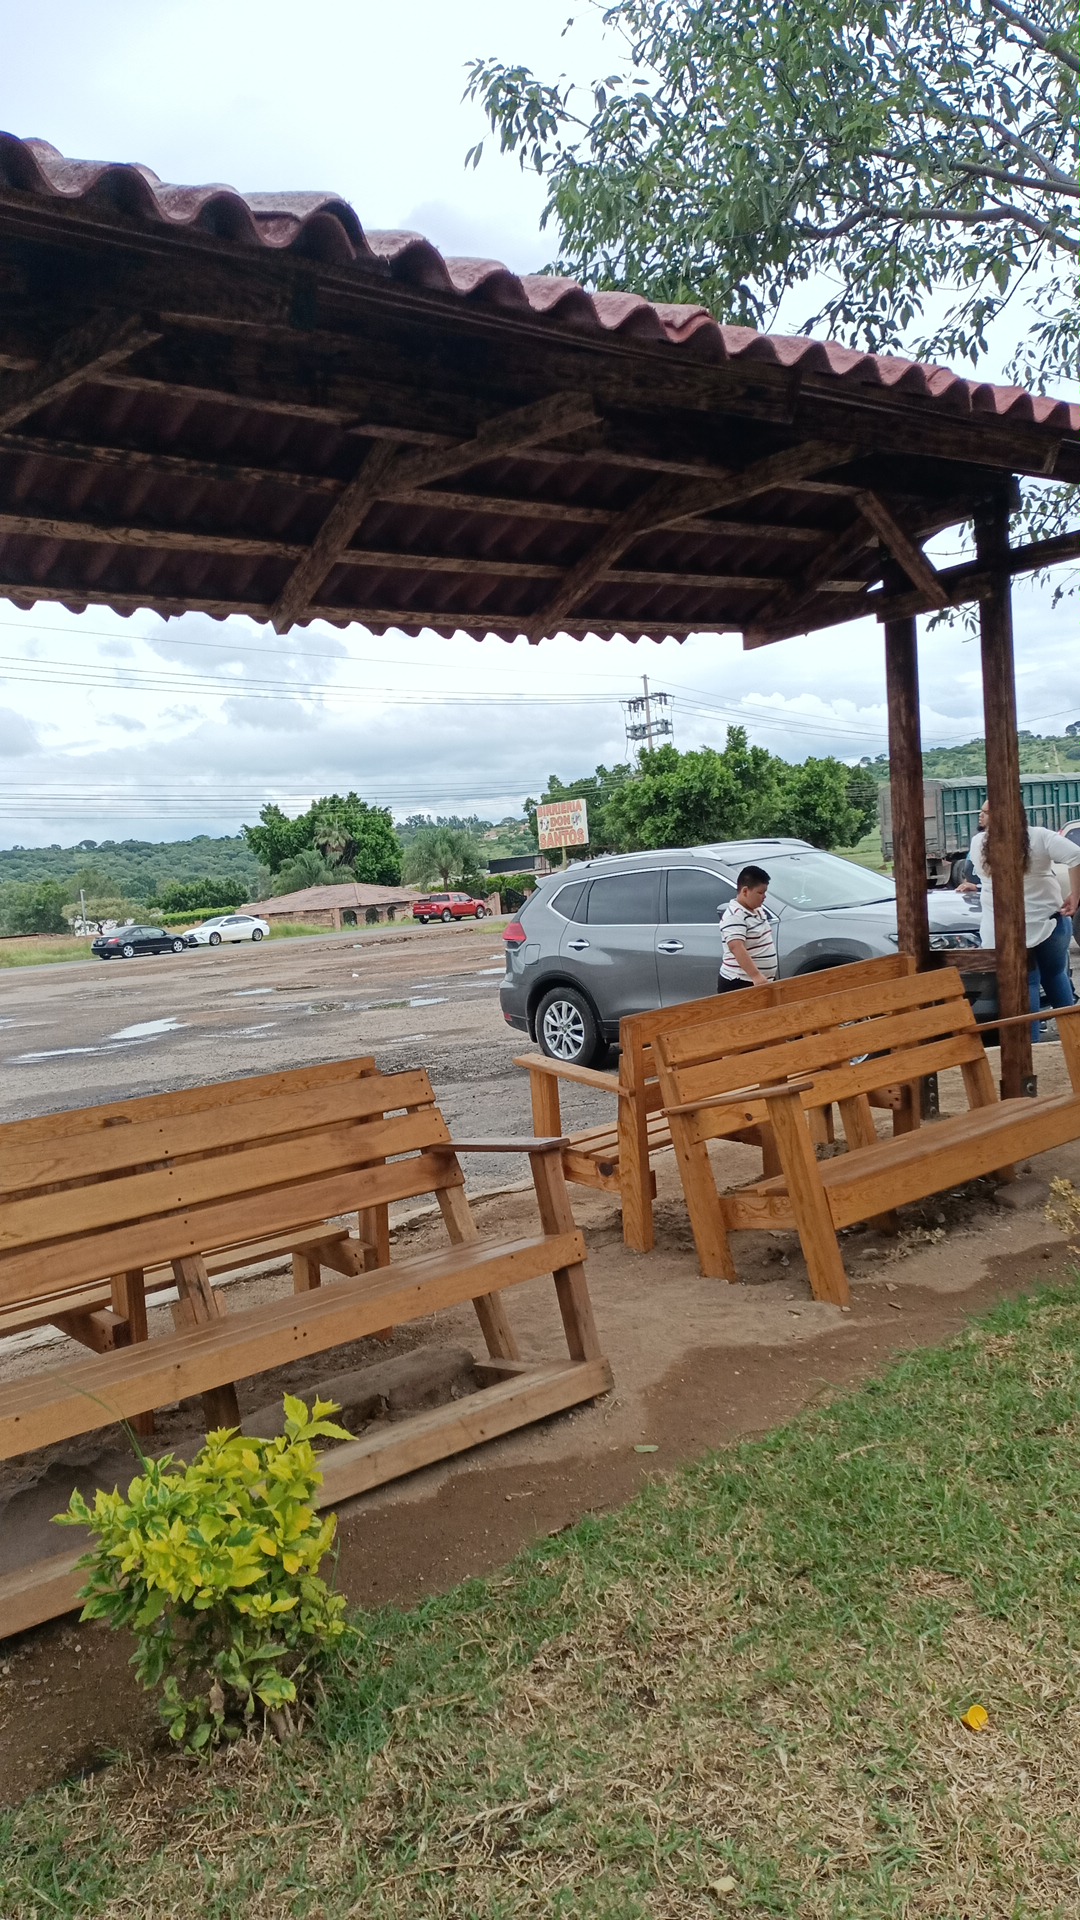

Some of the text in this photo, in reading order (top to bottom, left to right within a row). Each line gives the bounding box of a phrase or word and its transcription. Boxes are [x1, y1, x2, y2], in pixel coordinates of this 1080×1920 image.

[537, 800, 582, 817] BIRRIERIA
[550, 815, 570, 827] DON
[540, 828, 584, 848] SANTOS
